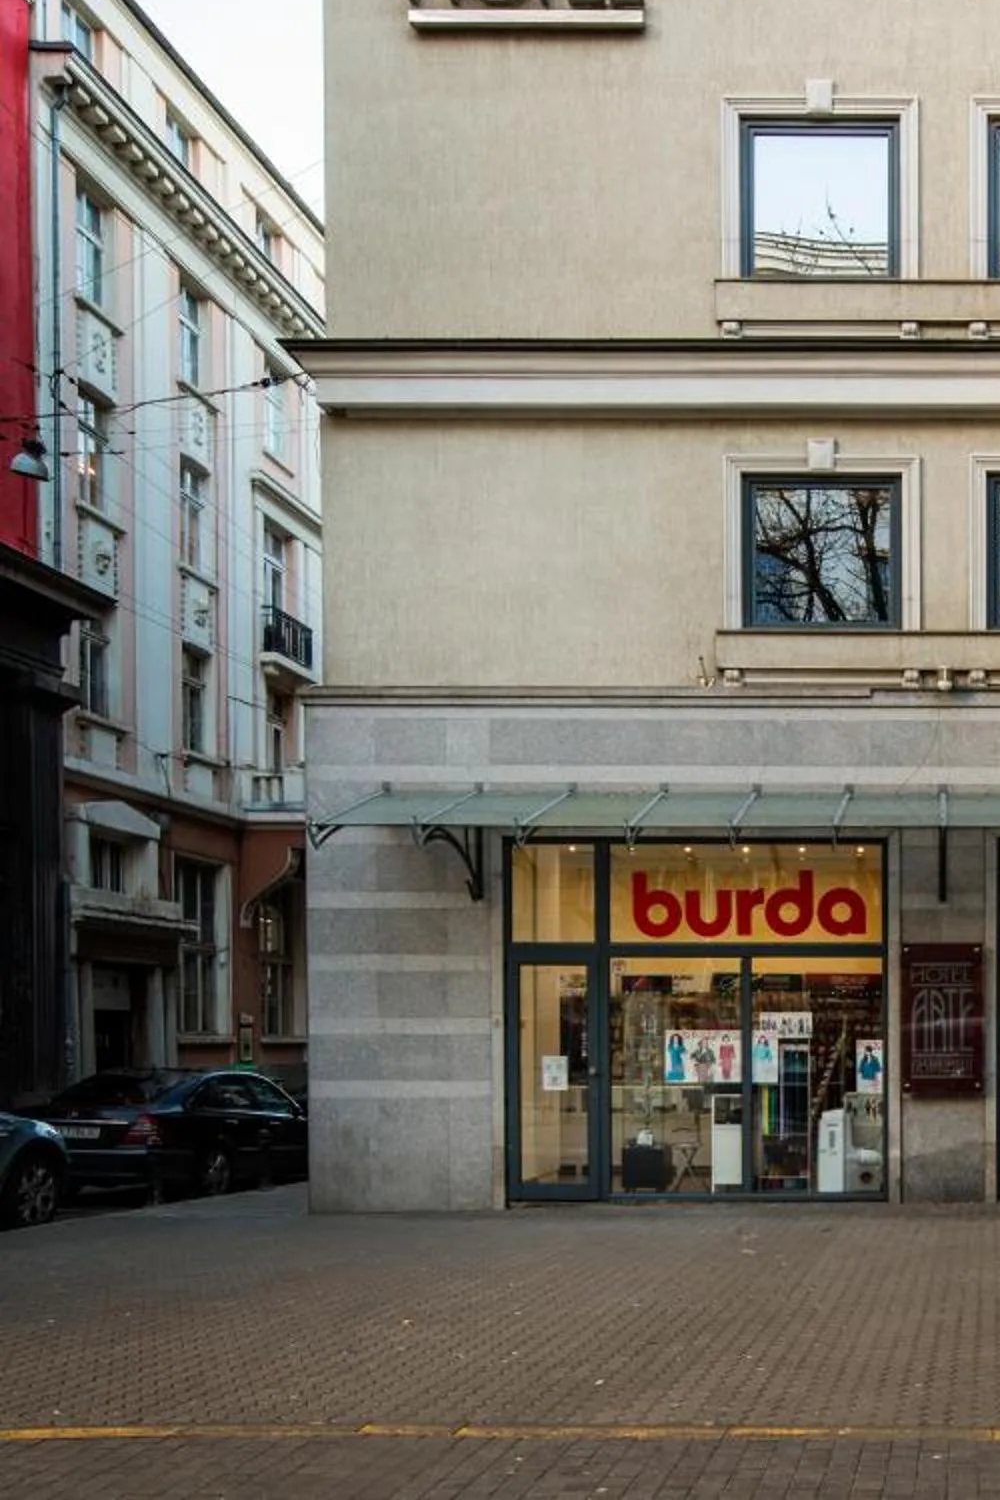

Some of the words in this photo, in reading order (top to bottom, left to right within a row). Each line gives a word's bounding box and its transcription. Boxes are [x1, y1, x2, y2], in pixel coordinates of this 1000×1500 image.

[632, 870, 867, 938] burda
[911, 967, 973, 982] HOTEL
[911, 988, 974, 1052] ARTE
